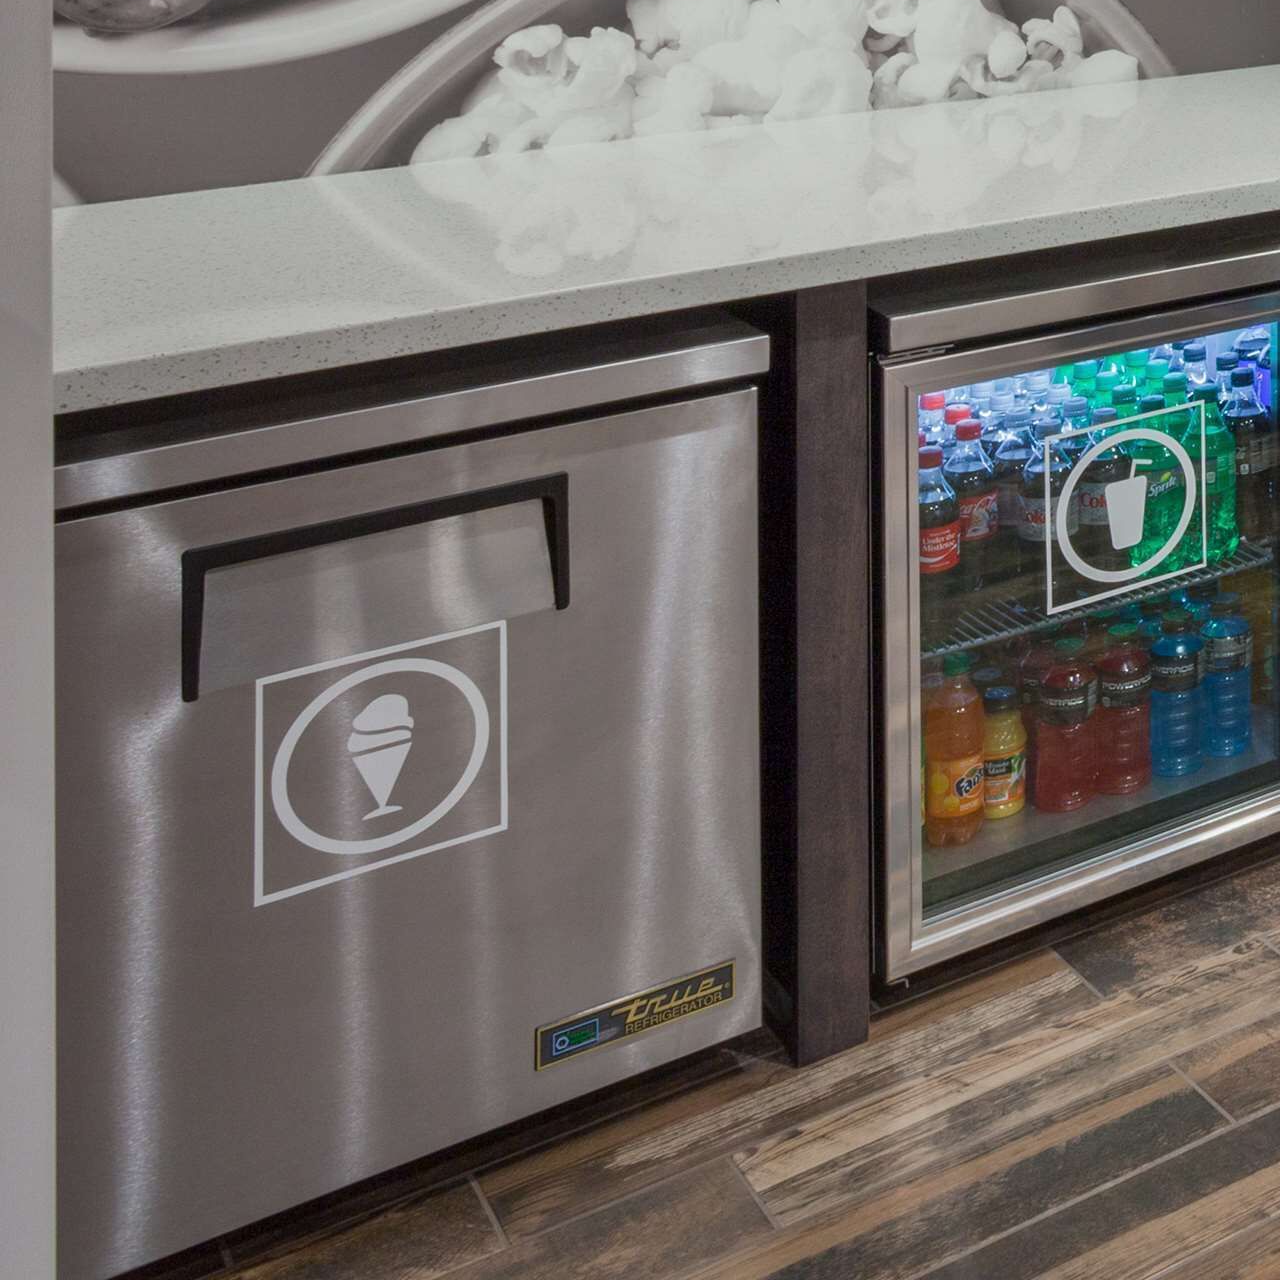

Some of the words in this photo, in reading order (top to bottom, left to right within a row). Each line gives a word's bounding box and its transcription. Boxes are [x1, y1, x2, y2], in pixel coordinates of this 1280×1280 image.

[1148, 477, 1177, 497] Sprite
[956, 768, 984, 797] Fan
[625, 992, 722, 1034] REFRIGERATOR
